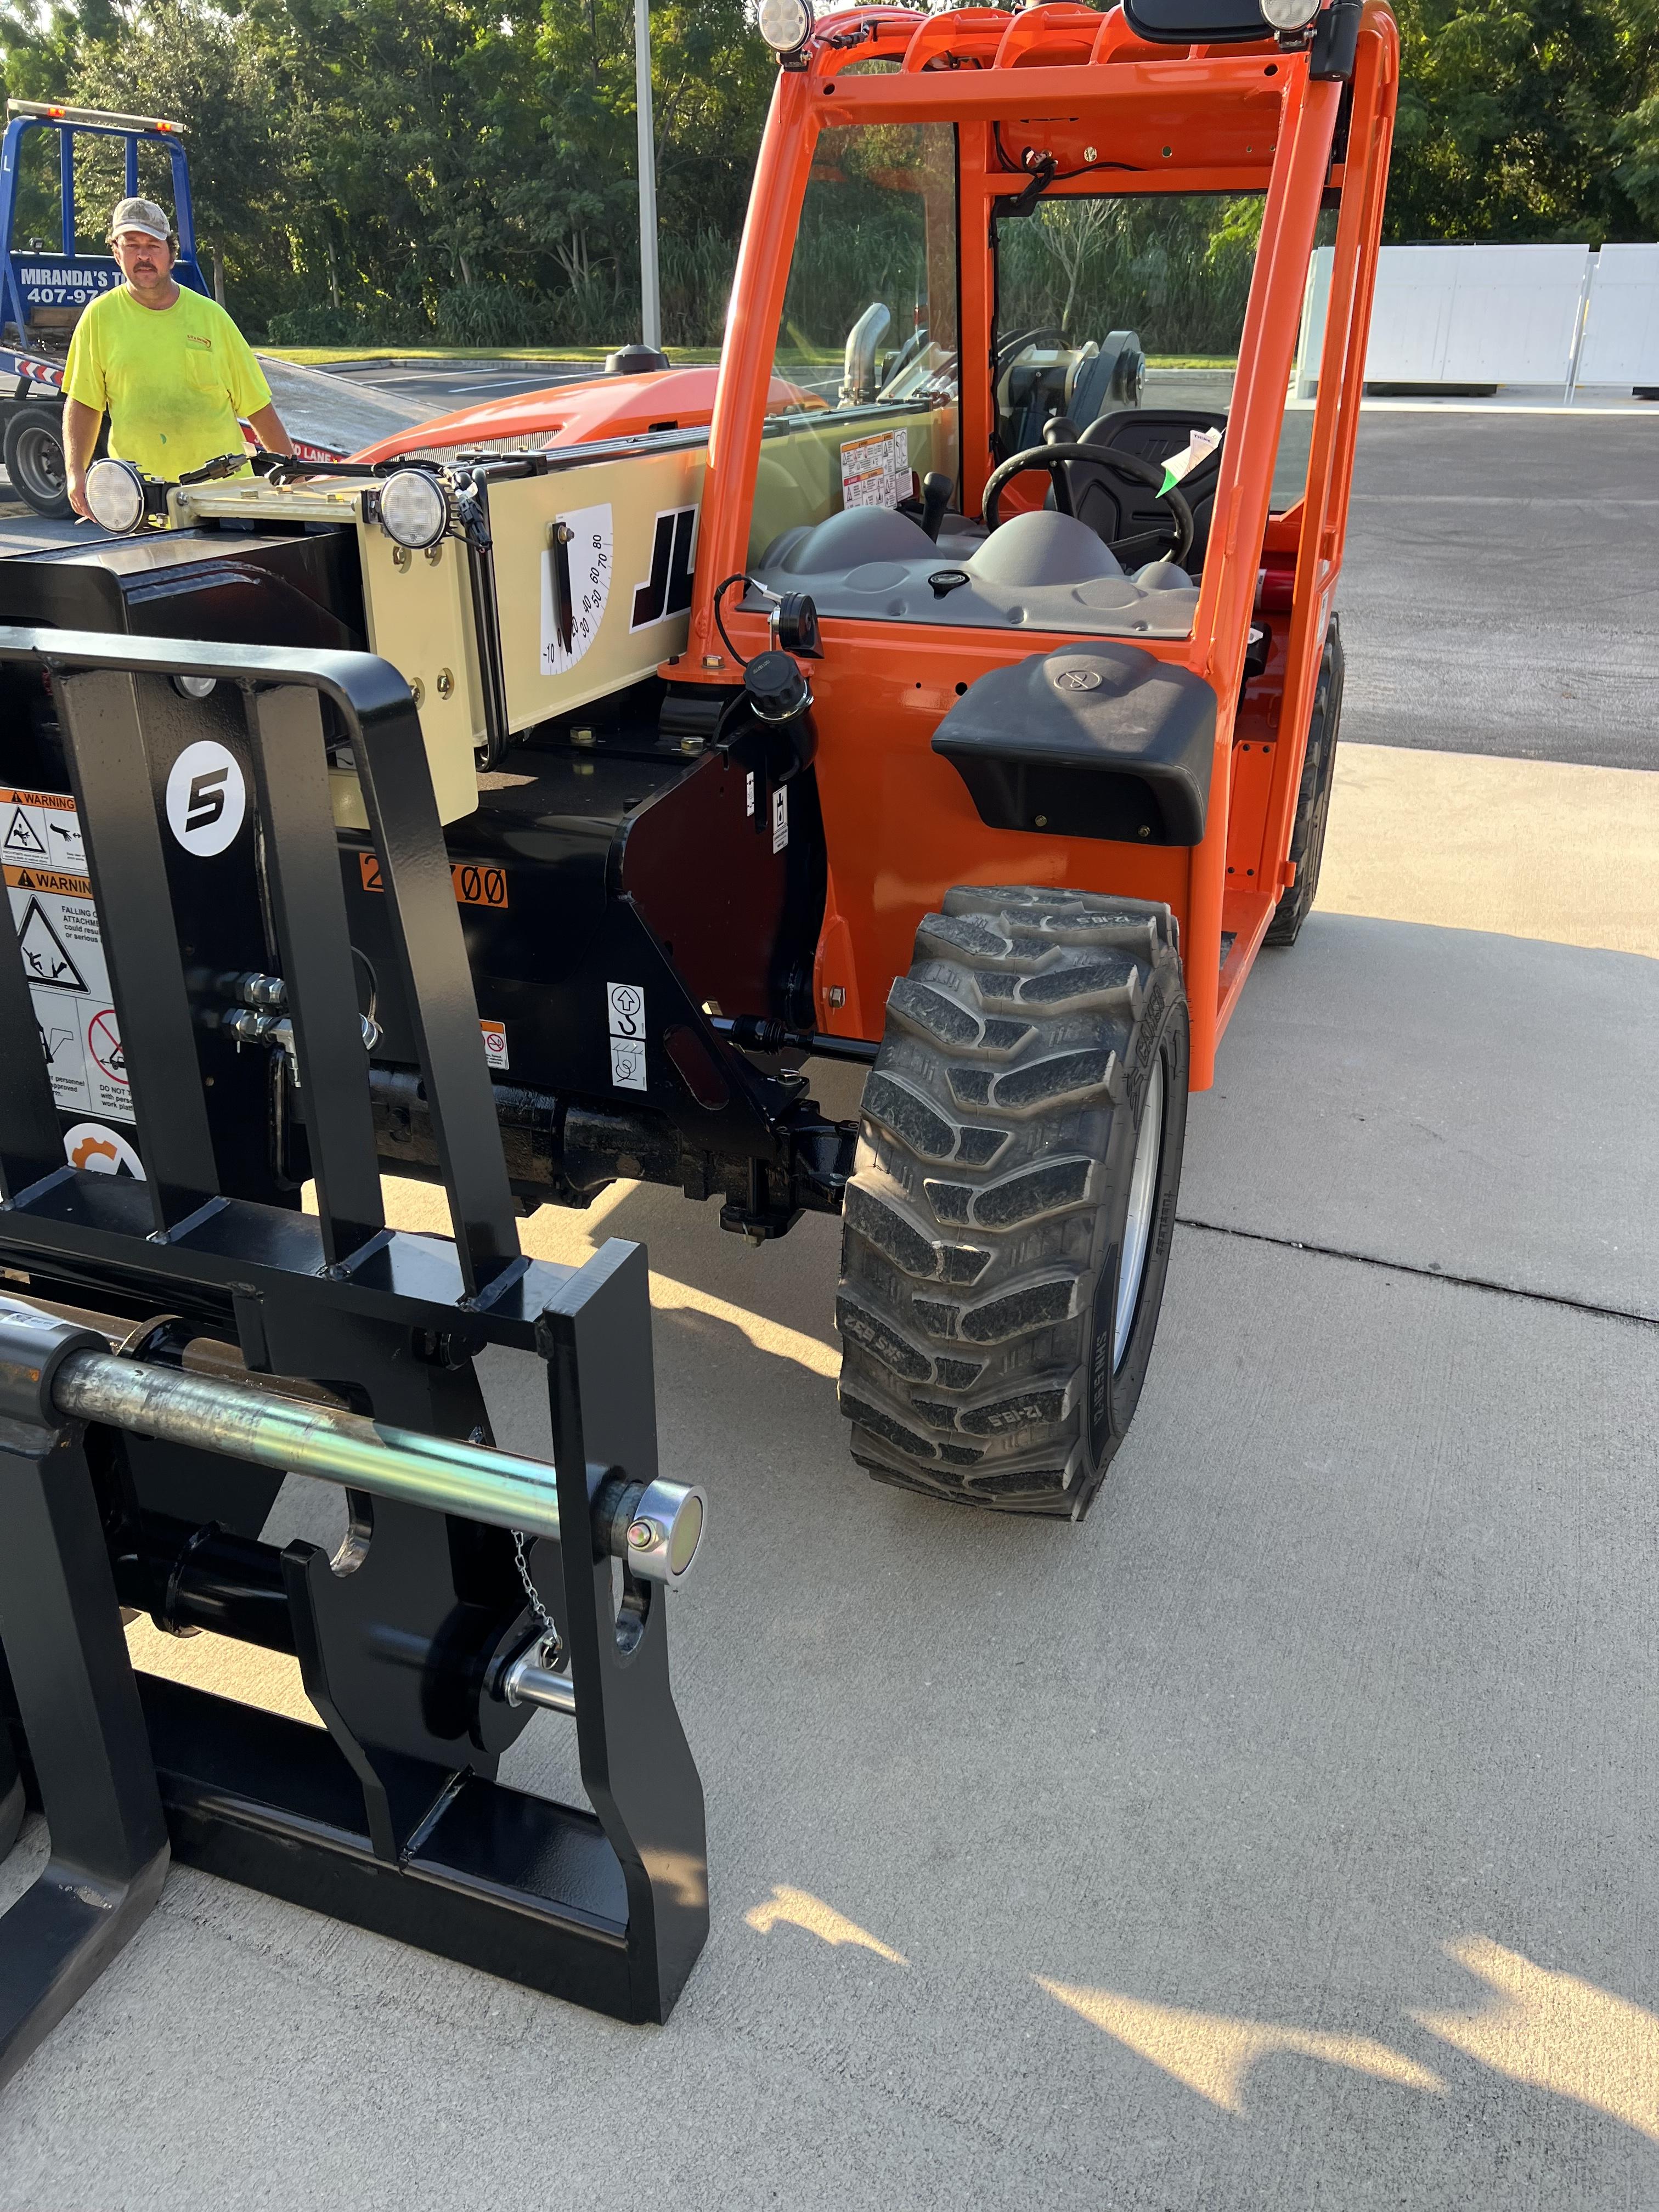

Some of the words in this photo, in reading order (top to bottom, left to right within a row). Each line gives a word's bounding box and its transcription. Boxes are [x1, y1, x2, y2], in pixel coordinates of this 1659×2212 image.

[21, 268, 108, 287] MIRANDA'S
[27, 288, 108, 303] 407-97
[304, 447, 331, 462] LANE
[592, 534, 602, 549] 80
[597, 553, 607, 569] 70
[630, 506, 697, 631] JL
[590, 567, 600, 584] 60
[583, 595, 591, 613] 40
[591, 589, 601, 608] 50
[579, 617, 589, 639] 30
[24, 793, 75, 809] WARNING
[36, 873, 92, 895] WARNIN
[61, 906, 91, 917] FALLING
[74, 933, 98, 943] serious
[52, 1083, 78, 1093] pproved
[55, 1076, 85, 1087] personnel
[111, 1086, 125, 1095] NOT
[101, 1100, 117, 1108] work
